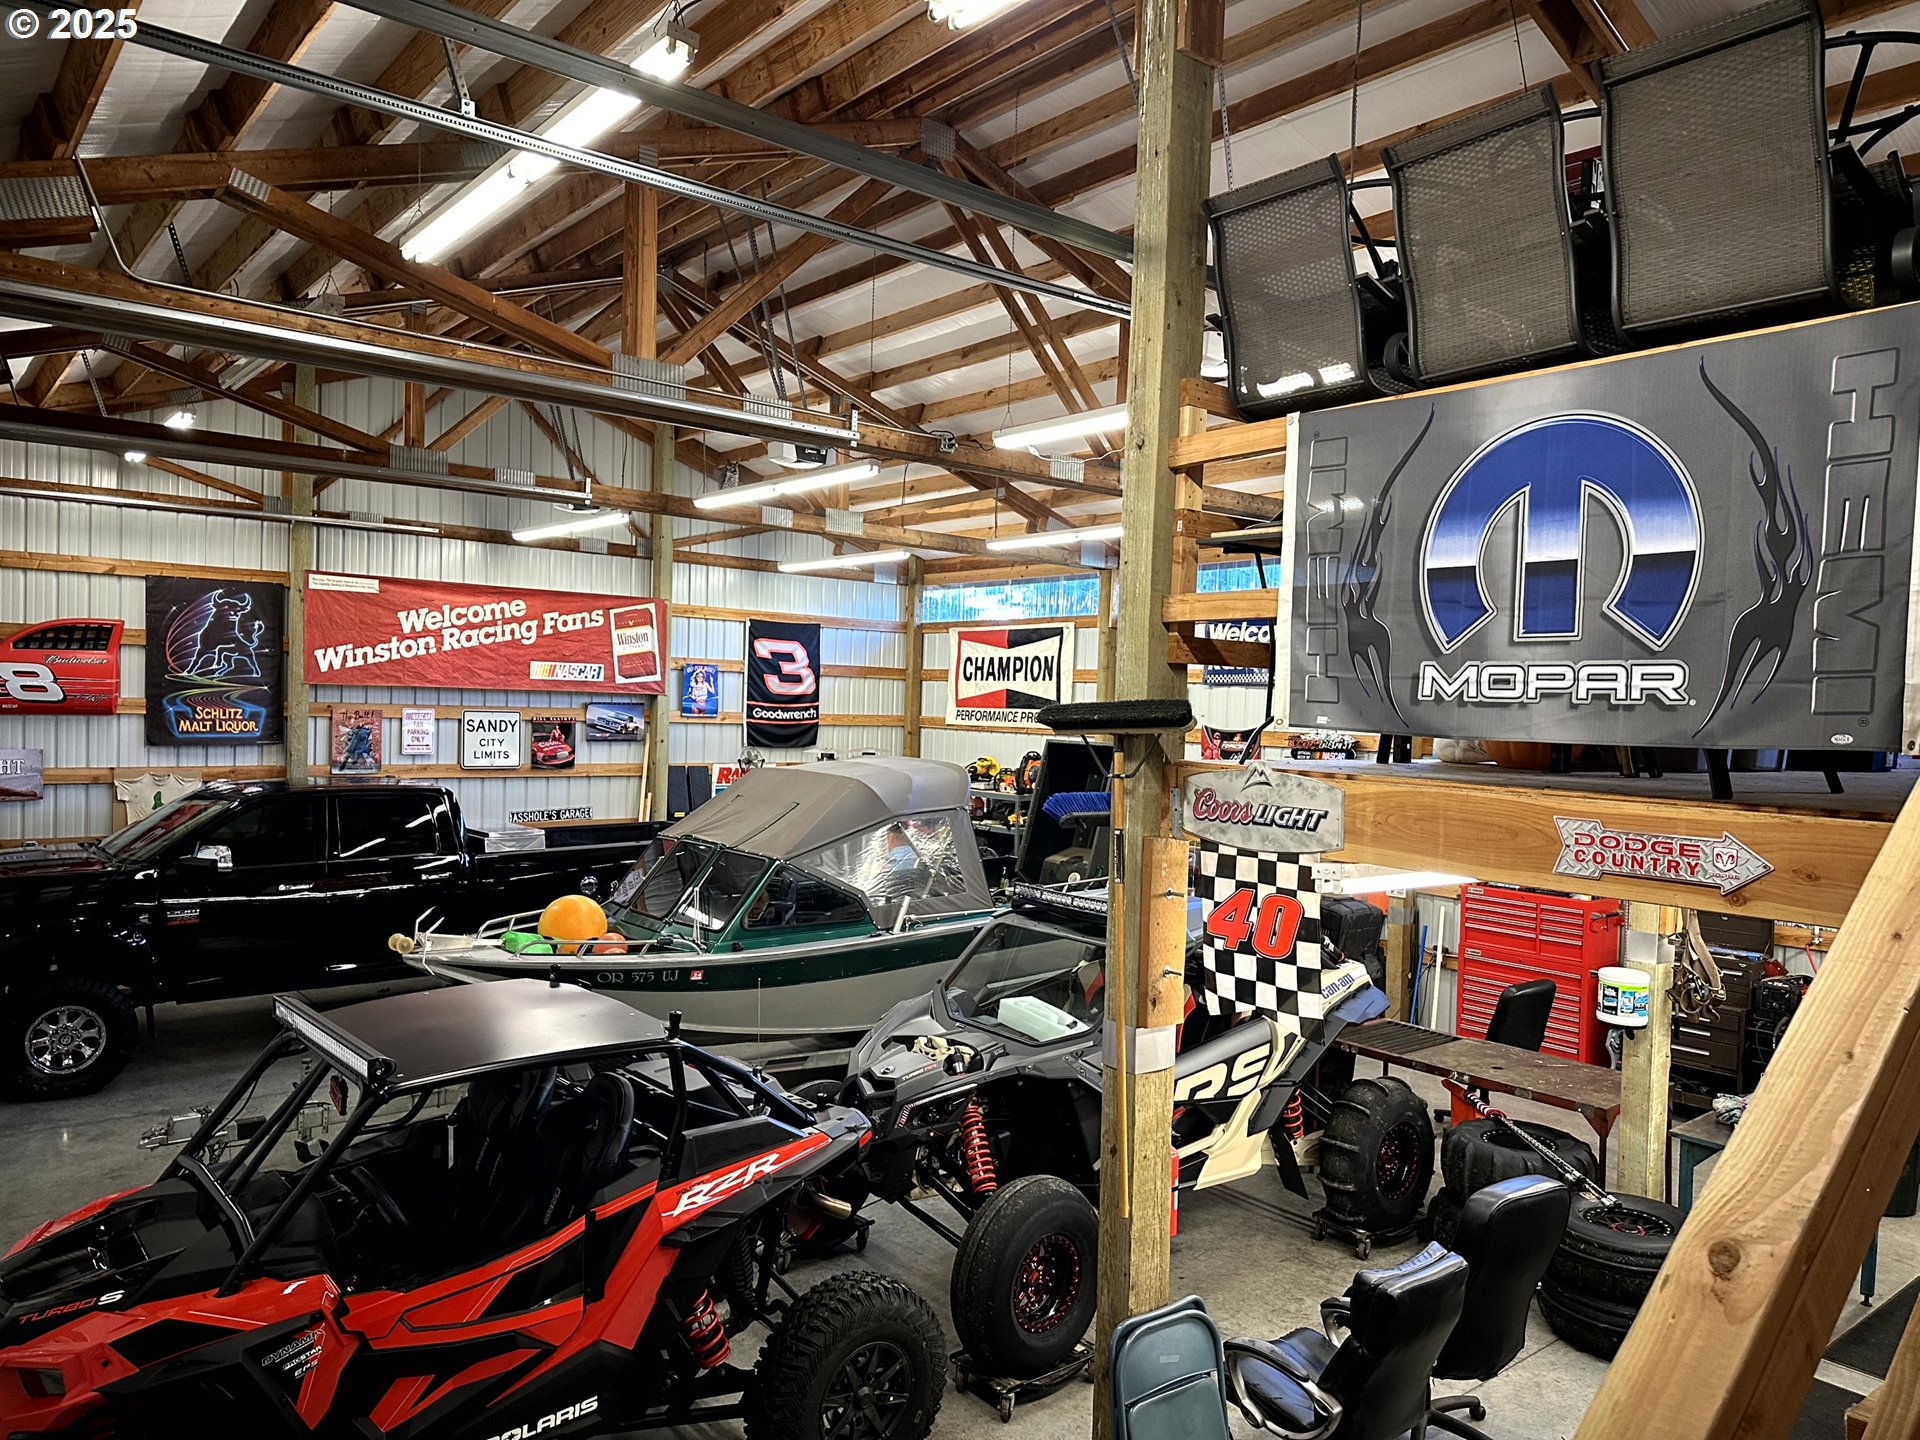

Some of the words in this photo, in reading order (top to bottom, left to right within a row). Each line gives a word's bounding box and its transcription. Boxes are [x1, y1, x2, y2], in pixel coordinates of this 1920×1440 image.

[1812, 346, 1900, 716] HEMI
[397, 599, 527, 634] Welcome
[314, 633, 436, 673] Winston
[441, 617, 538, 652] Racing
[542, 608, 604, 635] Fans
[617, 631, 649, 646] Winston
[1209, 621, 1271, 644] Welco
[43, 654, 110, 665] Budweiser
[553, 665, 600, 680] NASCAR
[753, 638, 817, 696] 3
[962, 655, 1056, 683] CHAMPION
[0, 661, 67, 705] 8
[1417, 659, 1690, 705] MOPAR
[194, 706, 243, 720] SCHLITZ
[466, 719, 517, 733] SANDY
[752, 706, 817, 721] Goodwrench
[955, 709, 1017, 724] PERFORMANCE
[178, 720, 210, 733] MALT
[215, 719, 259, 734] LIQUOR
[473, 750, 510, 760] LIMITS
[479, 738, 504, 748] CITY
[1321, 751, 1346, 760] NASCAR
[513, 811, 557, 823] ASSHOLE'S
[560, 808, 590, 820] GARAGE
[1193, 787, 1253, 824] Coors
[1252, 803, 1329, 833] LIGHT
[1574, 832, 1702, 859] DODGE
[1574, 849, 1702, 876] COUNTRY
[1206, 887, 1305, 960] 40
[597, 972, 624, 984] OR
[631, 971, 655, 983] 575
[662, 970, 680, 982] UJ
[1321, 973, 1356, 1000] can-am
[667, 1152, 780, 1218] RZR
[19, 1296, 97, 1325] TURBO
[97, 1289, 126, 1306] S
[283, 1345, 322, 1371] PROSTAR
